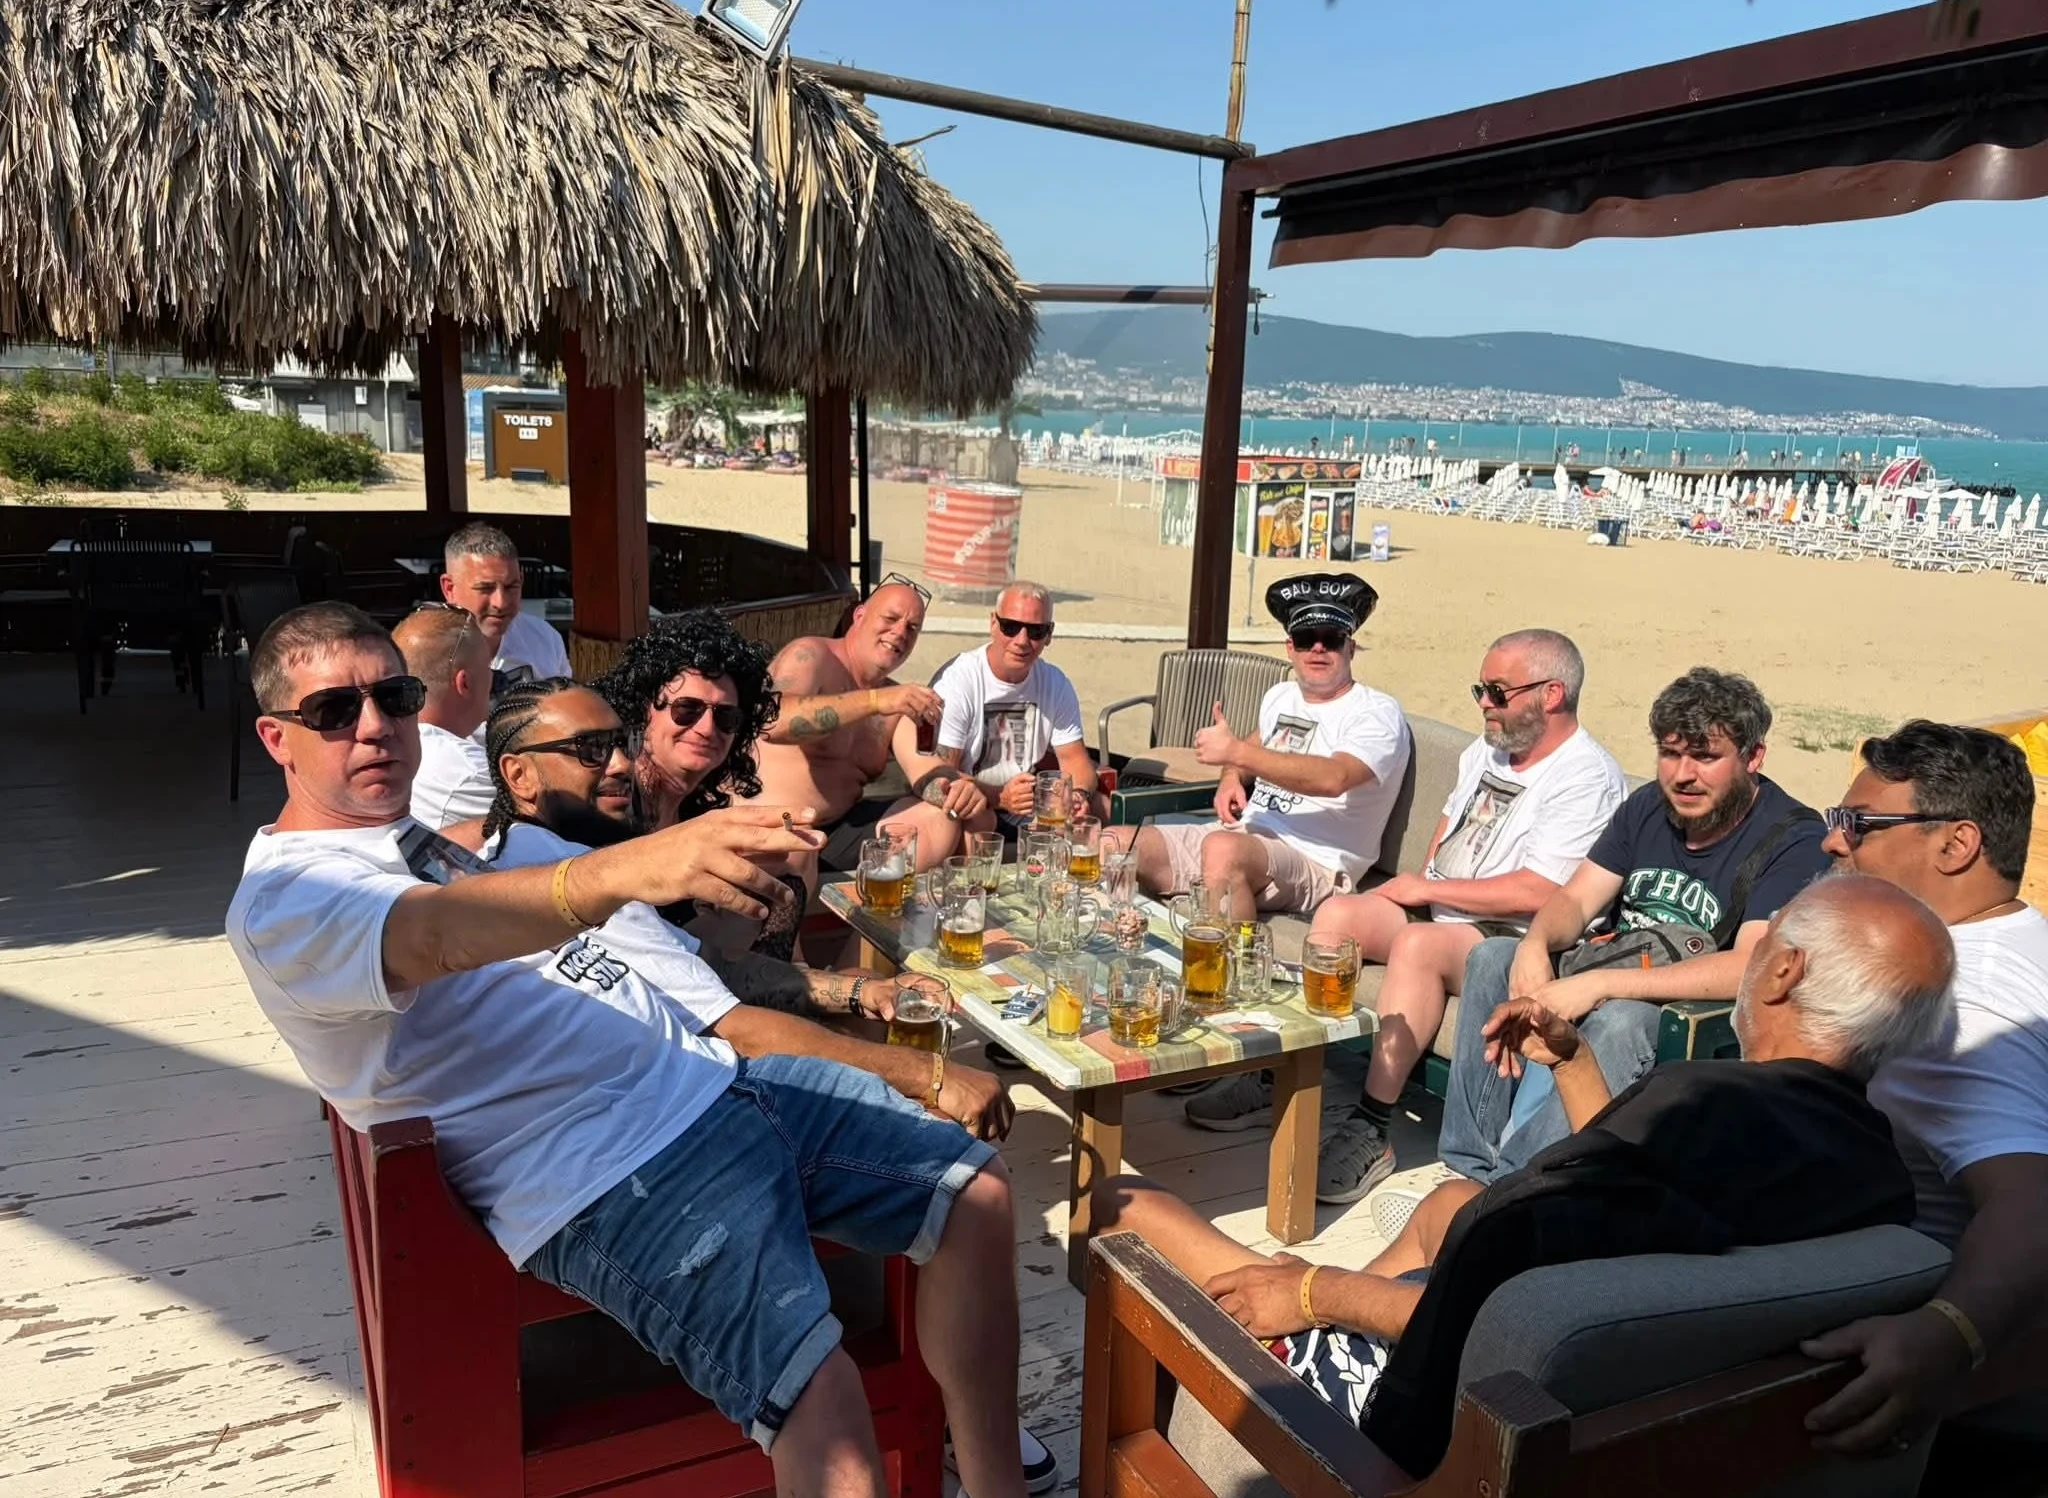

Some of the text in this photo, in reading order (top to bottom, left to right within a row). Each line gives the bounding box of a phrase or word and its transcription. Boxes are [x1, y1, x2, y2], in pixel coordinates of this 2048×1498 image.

[504, 414, 553, 427] TOILETS
[1281, 581, 1351, 600] BAD BOY
[1628, 868, 1721, 932] THOR
